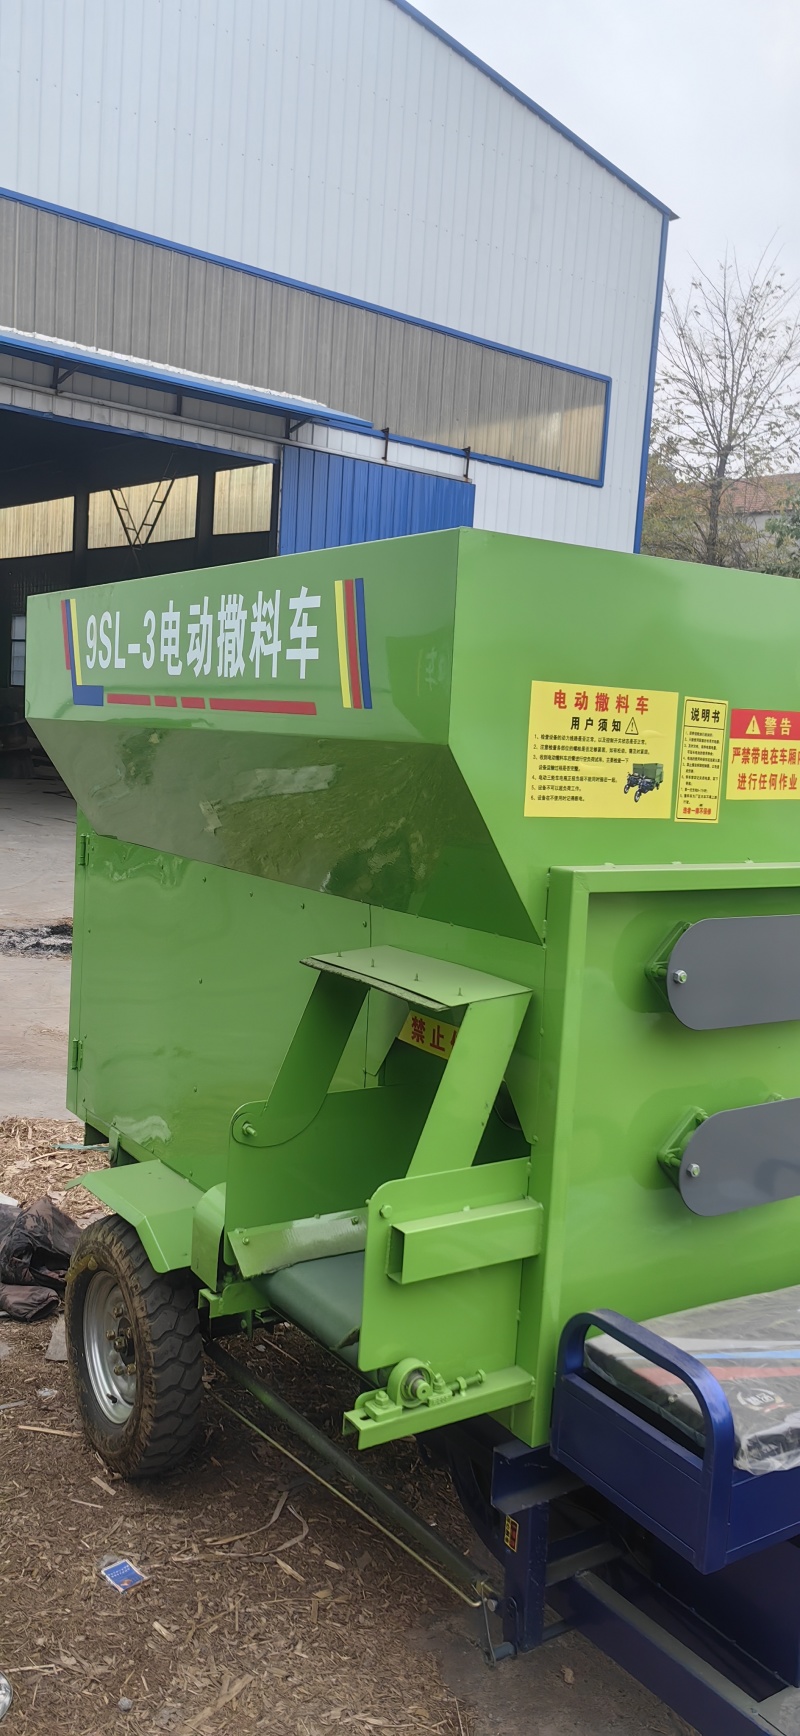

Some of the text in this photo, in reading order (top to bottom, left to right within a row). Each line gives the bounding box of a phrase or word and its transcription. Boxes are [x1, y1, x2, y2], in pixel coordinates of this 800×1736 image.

[86, 586, 321, 680] 9SL-3电动撒料车
[553, 689, 649, 715] 电动撒料车
[570, 716, 622, 732] 用户须知
[690, 707, 721, 723] 说明书
[764, 716, 792, 736] 警告
[737, 772, 798, 791] 进行任何作业
